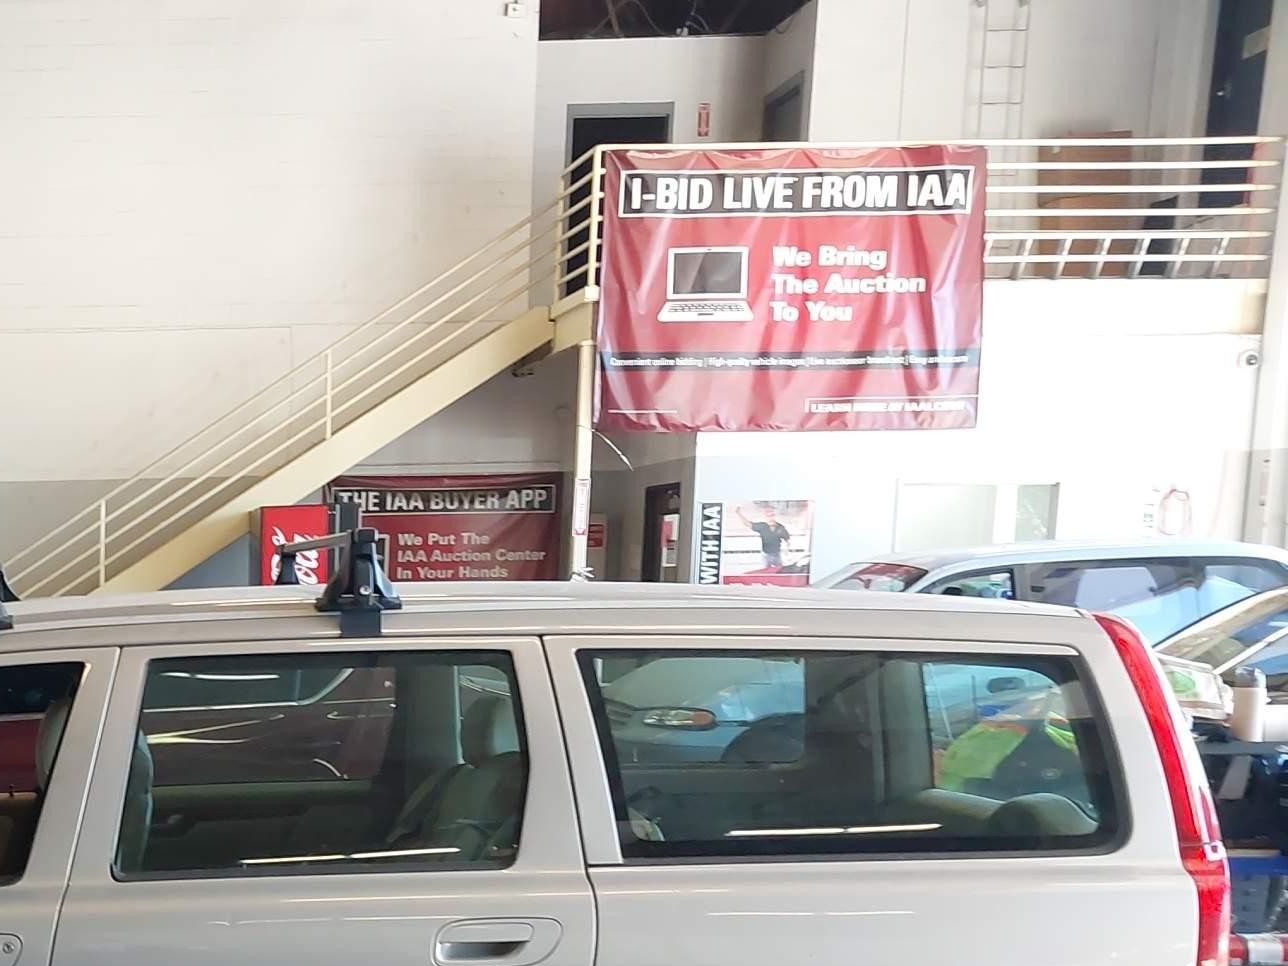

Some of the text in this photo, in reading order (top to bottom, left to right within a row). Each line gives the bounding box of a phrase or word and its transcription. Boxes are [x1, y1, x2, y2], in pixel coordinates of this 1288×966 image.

[631, 172, 966, 210] I-BID LIVE FROM IAA
[772, 244, 888, 271] We Bring
[770, 273, 927, 294] The Auction
[769, 301, 854, 322] To You
[386, 491, 425, 511] IAA
[429, 491, 500, 511] BUYER
[505, 489, 547, 509] APP
[397, 533, 490, 546] We Put The
[700, 505, 721, 584] WITH IAA
[397, 550, 546, 563] IAA Auction Center
[397, 566, 508, 579] In Your Hands
